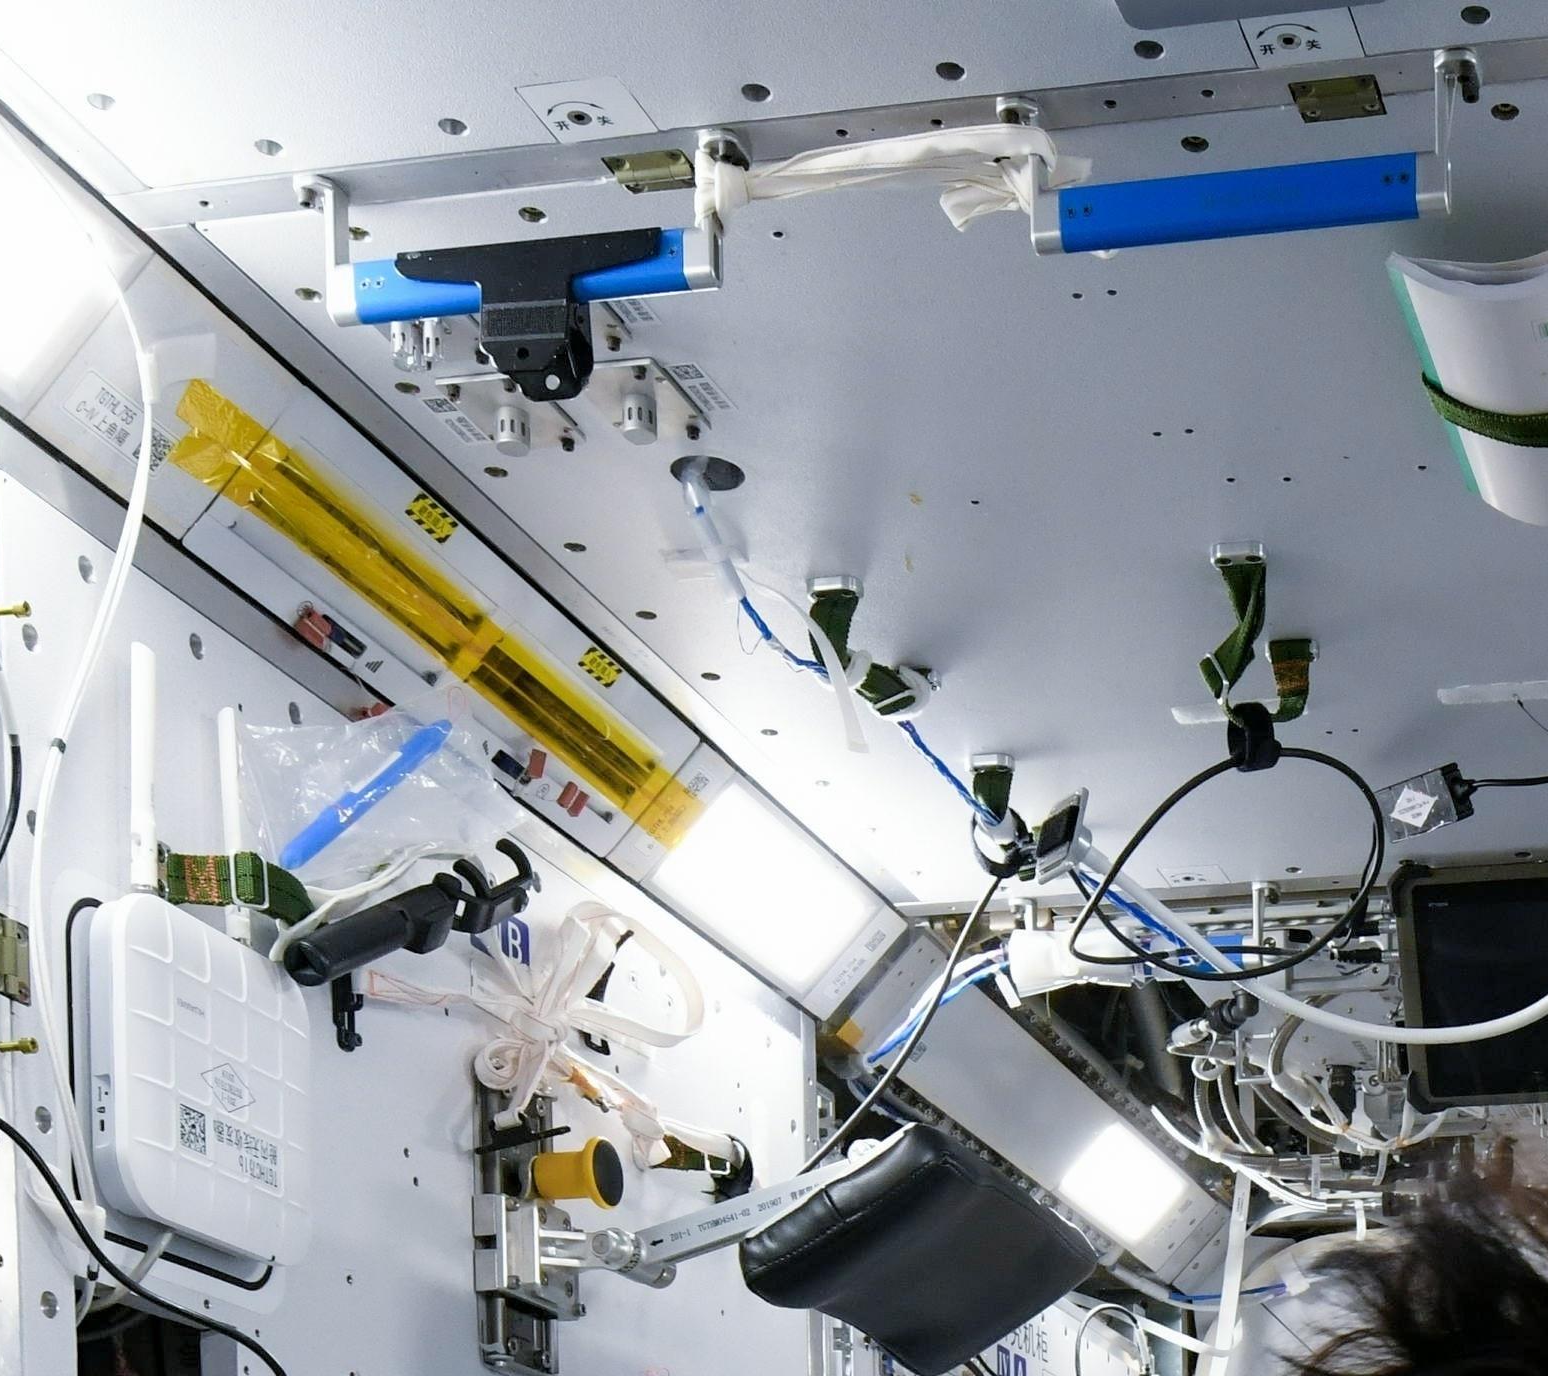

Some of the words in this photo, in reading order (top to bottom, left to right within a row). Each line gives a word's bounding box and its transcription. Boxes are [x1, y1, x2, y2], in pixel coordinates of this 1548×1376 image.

[1260, 43, 1275, 55] 开
[1305, 39, 1321, 50] 关
[555, 120, 570, 131] 开
[597, 115, 614, 126] 关
